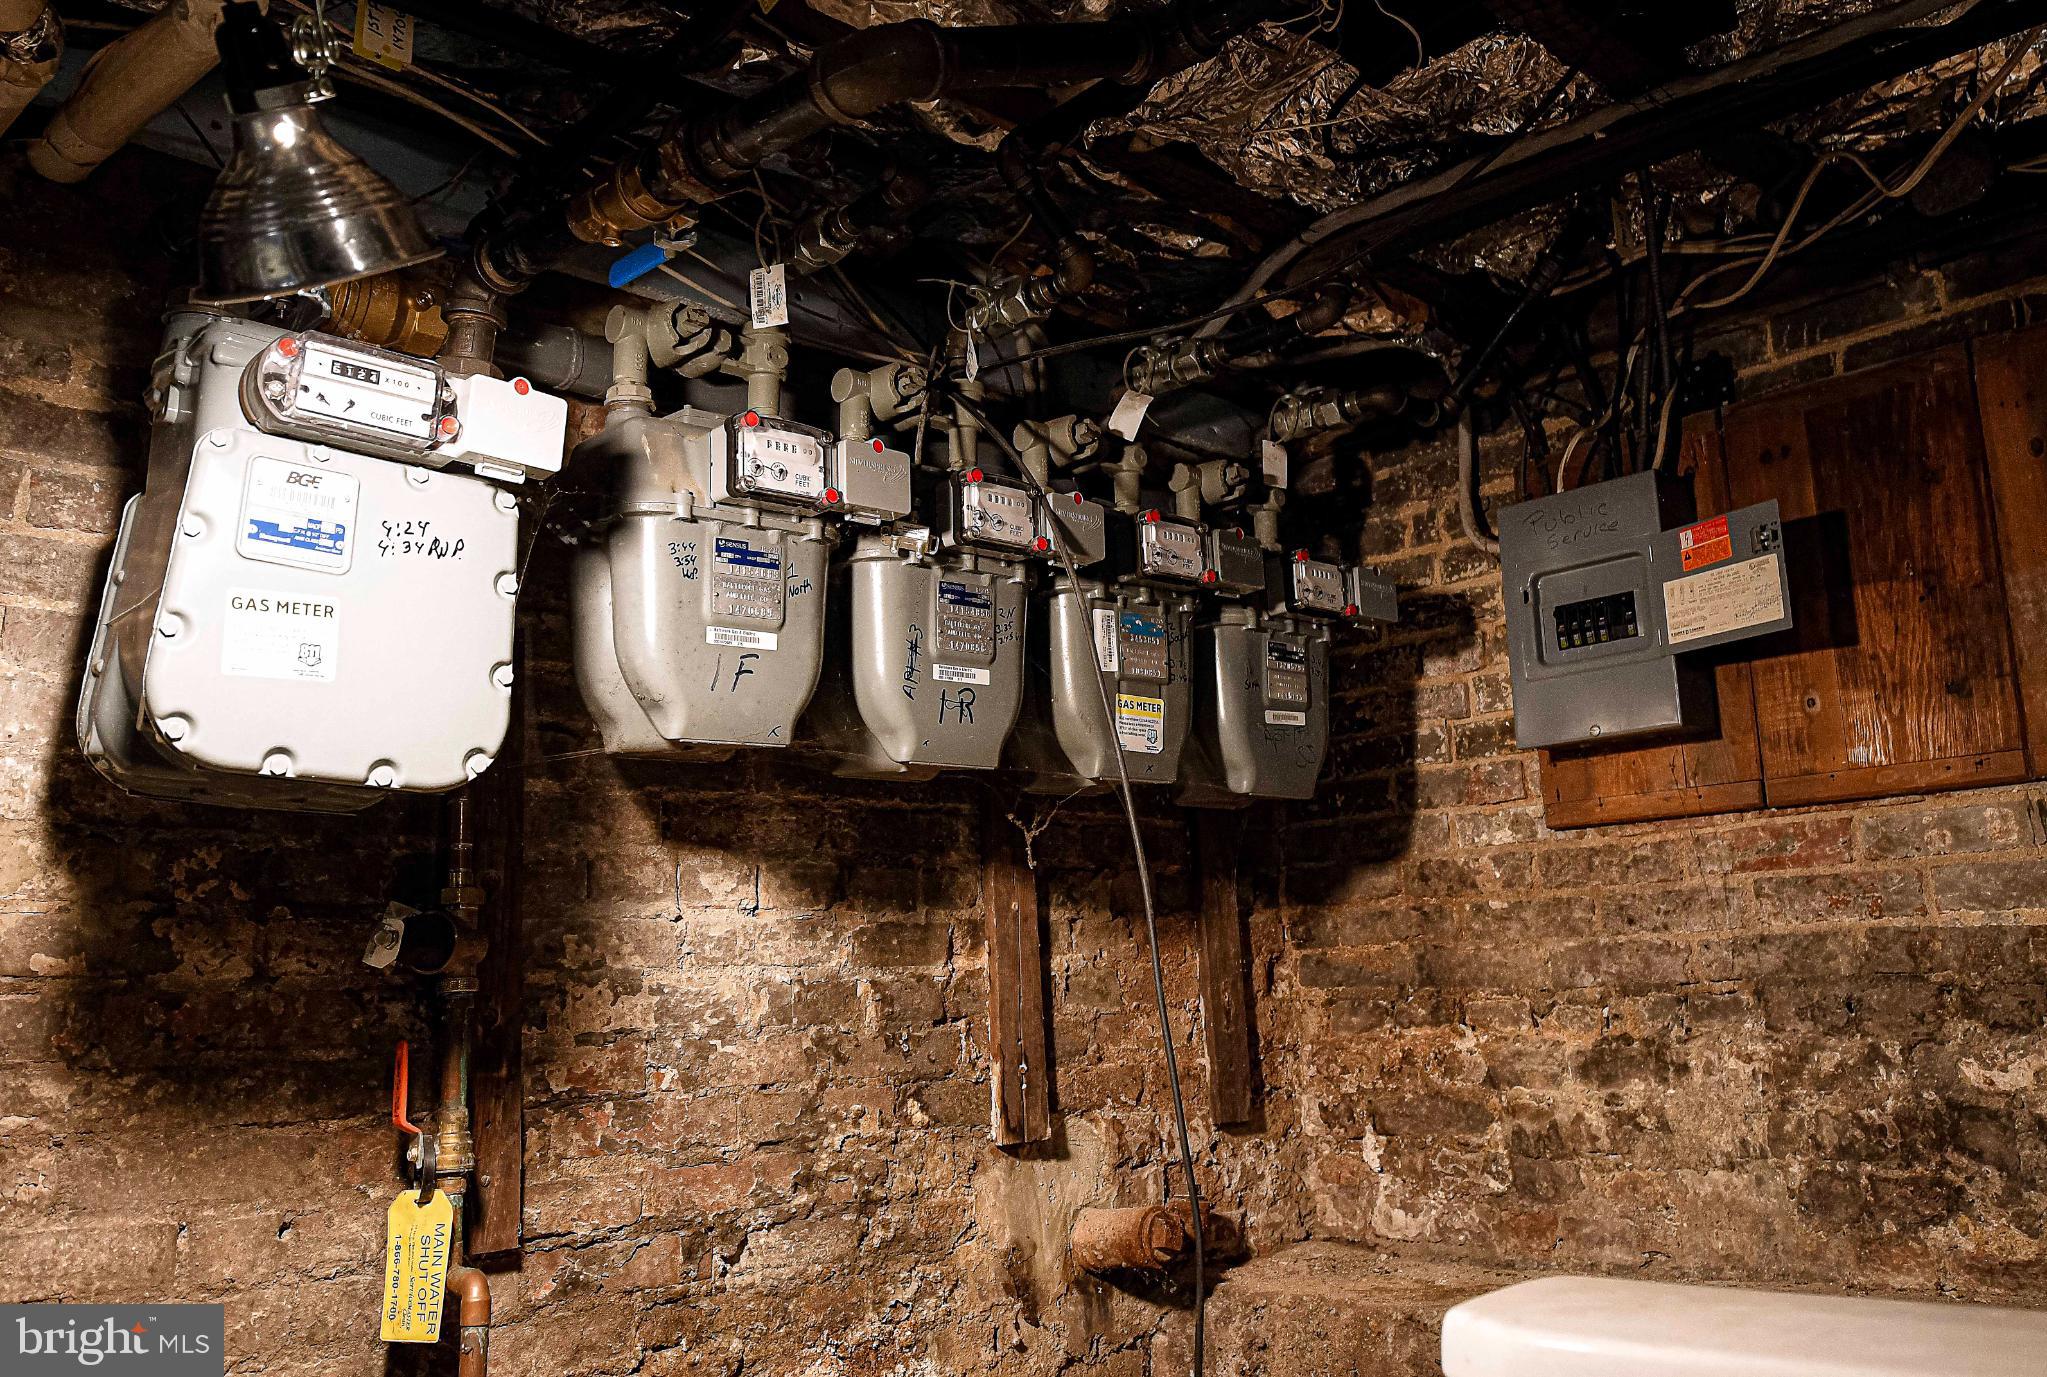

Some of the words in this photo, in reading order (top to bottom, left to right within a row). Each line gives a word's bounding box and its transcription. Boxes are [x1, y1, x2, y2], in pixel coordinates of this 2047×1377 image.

[370, 411, 394, 424] CUBIC
[396, 417, 413, 428] FEET
[287, 471, 322, 488] BGE
[382, 520, 430, 538] 4:24
[1522, 503, 1609, 536] Public
[378, 540, 424, 557] 4:34
[668, 541, 697, 555] 3:44
[788, 579, 812, 598] North
[231, 597, 269, 612] GAS
[276, 600, 334, 619] METER
[1117, 699, 1135, 710] GAS
[1136, 701, 1162, 713] METER
[431, 1223, 446, 1267] MAIN
[418, 1234, 431, 1282] SHUT
[388, 1234, 402, 1321] 1-866-780-1700
[416, 1287, 427, 1323] OFF
[426, 1272, 442, 1335] WATER
